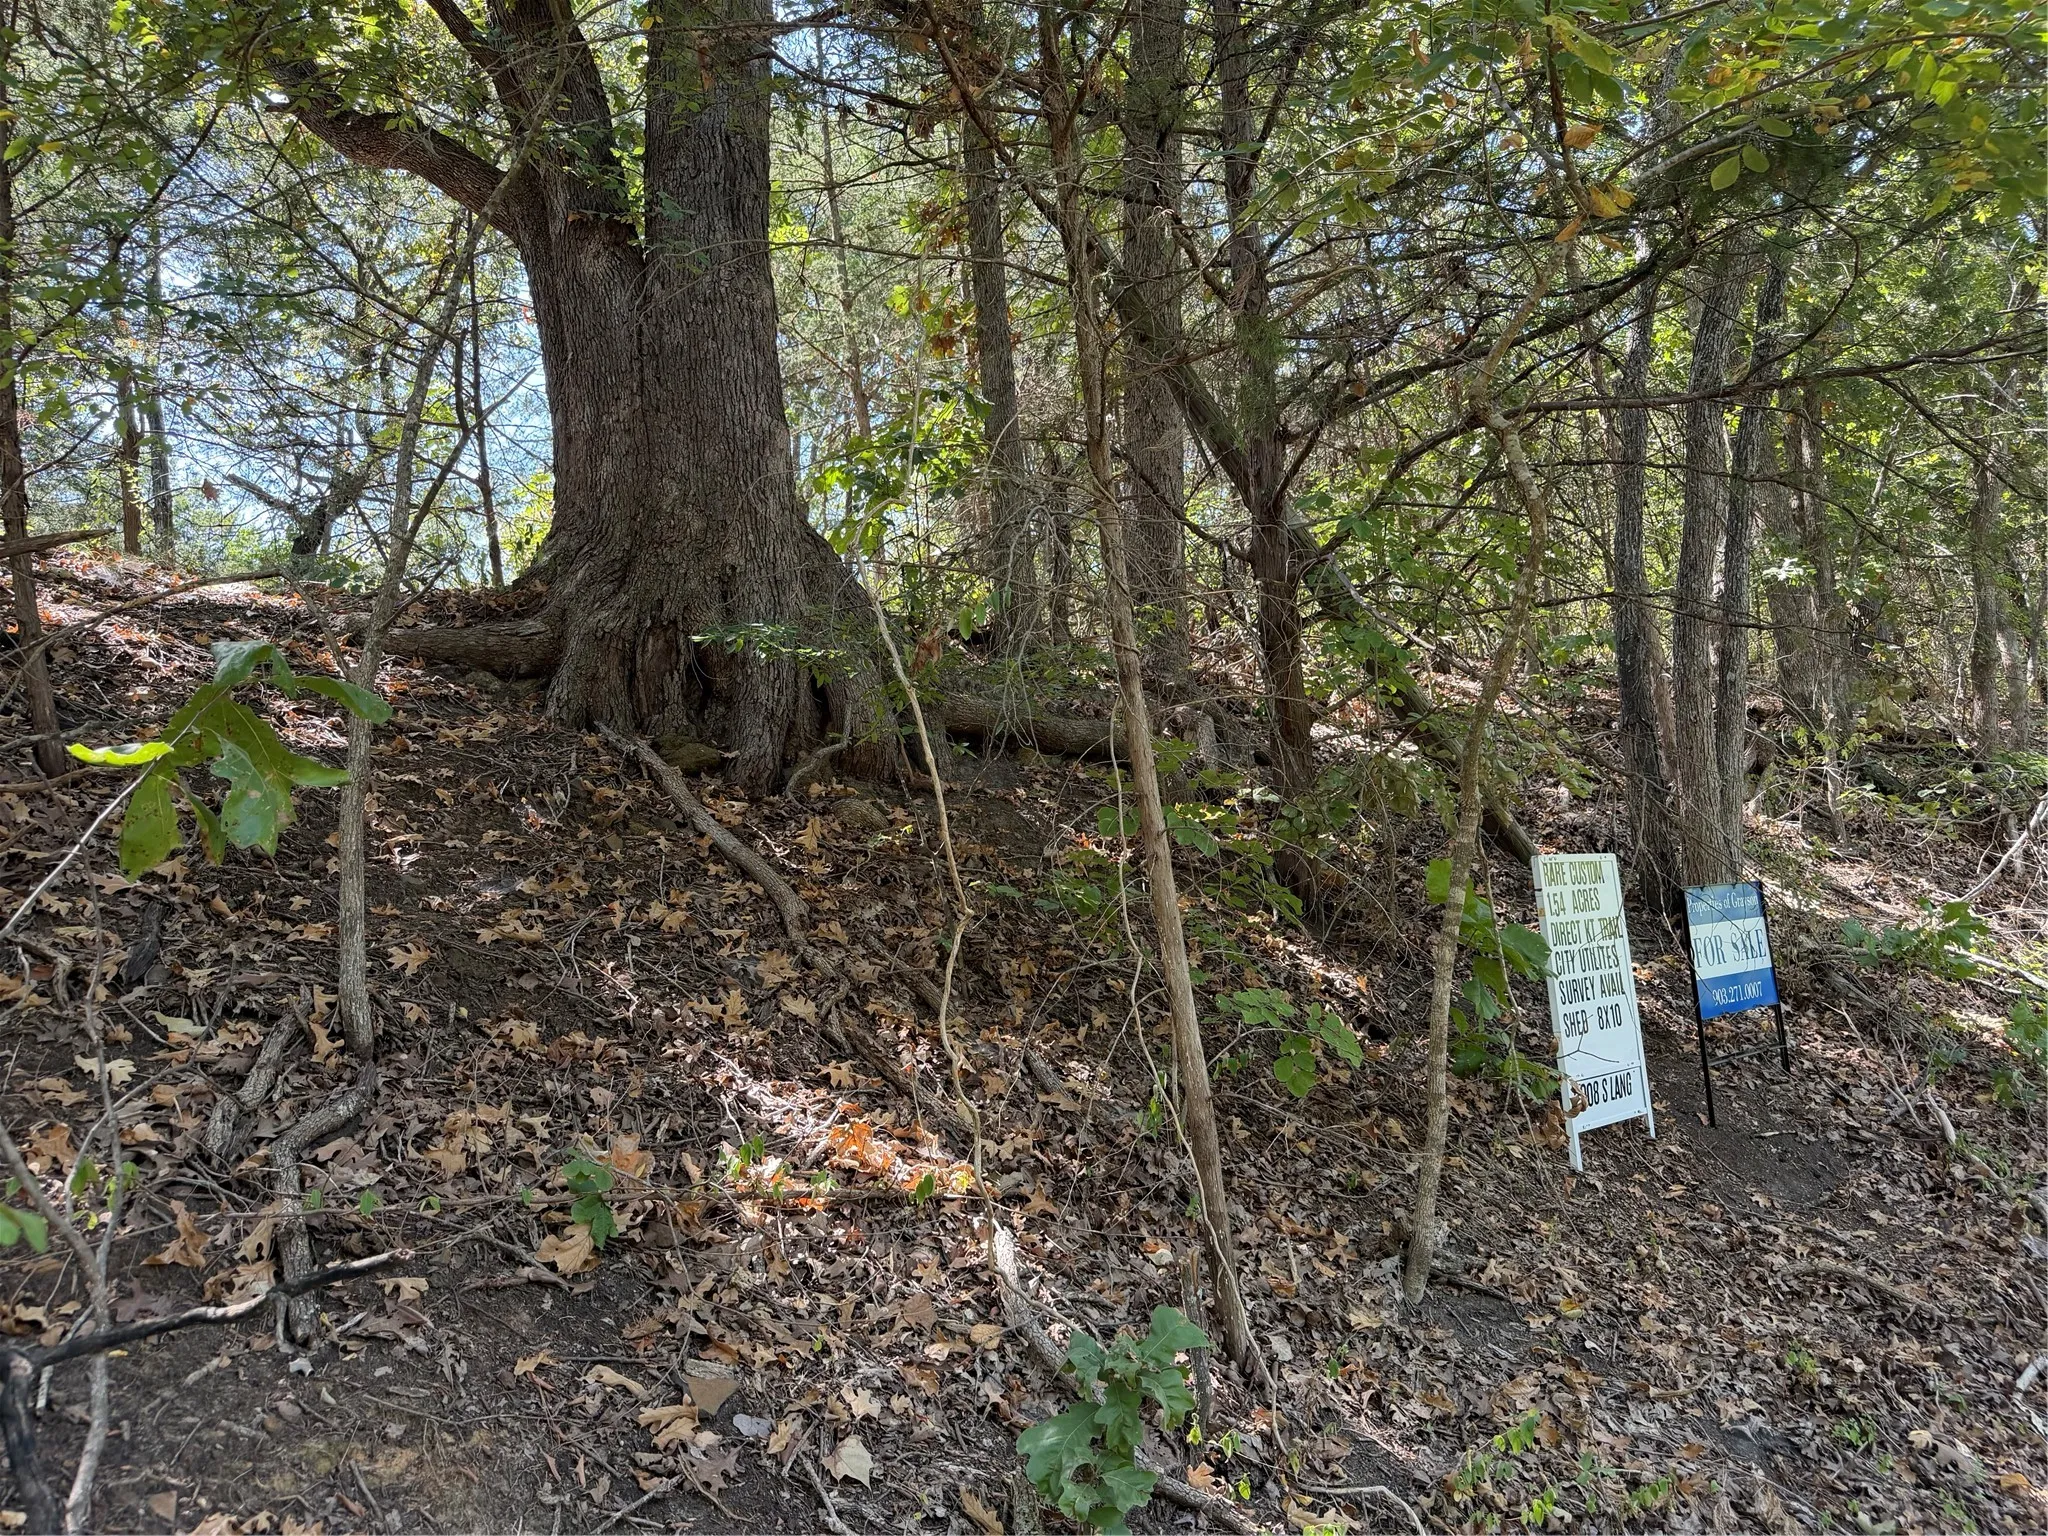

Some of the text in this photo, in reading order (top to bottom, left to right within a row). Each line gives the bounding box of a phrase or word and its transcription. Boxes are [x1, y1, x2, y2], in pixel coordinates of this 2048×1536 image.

[1543, 859, 1605, 888] RARE CUSTOM
[1546, 887, 1601, 917] 1.54 ACRES
[1723, 892, 1731, 910] of
[1550, 916, 1624, 947] DIRECT KT TRAIL
[1554, 949, 1576, 976] CITY
[1692, 928, 1767, 969] FOR SALE
[1558, 971, 1626, 1006] SURVEY AVAIL
[1562, 1002, 1623, 1038] SHED 8X10
[1602, 1077, 1609, 1103] S
[1610, 1071, 1633, 1101] LANG
